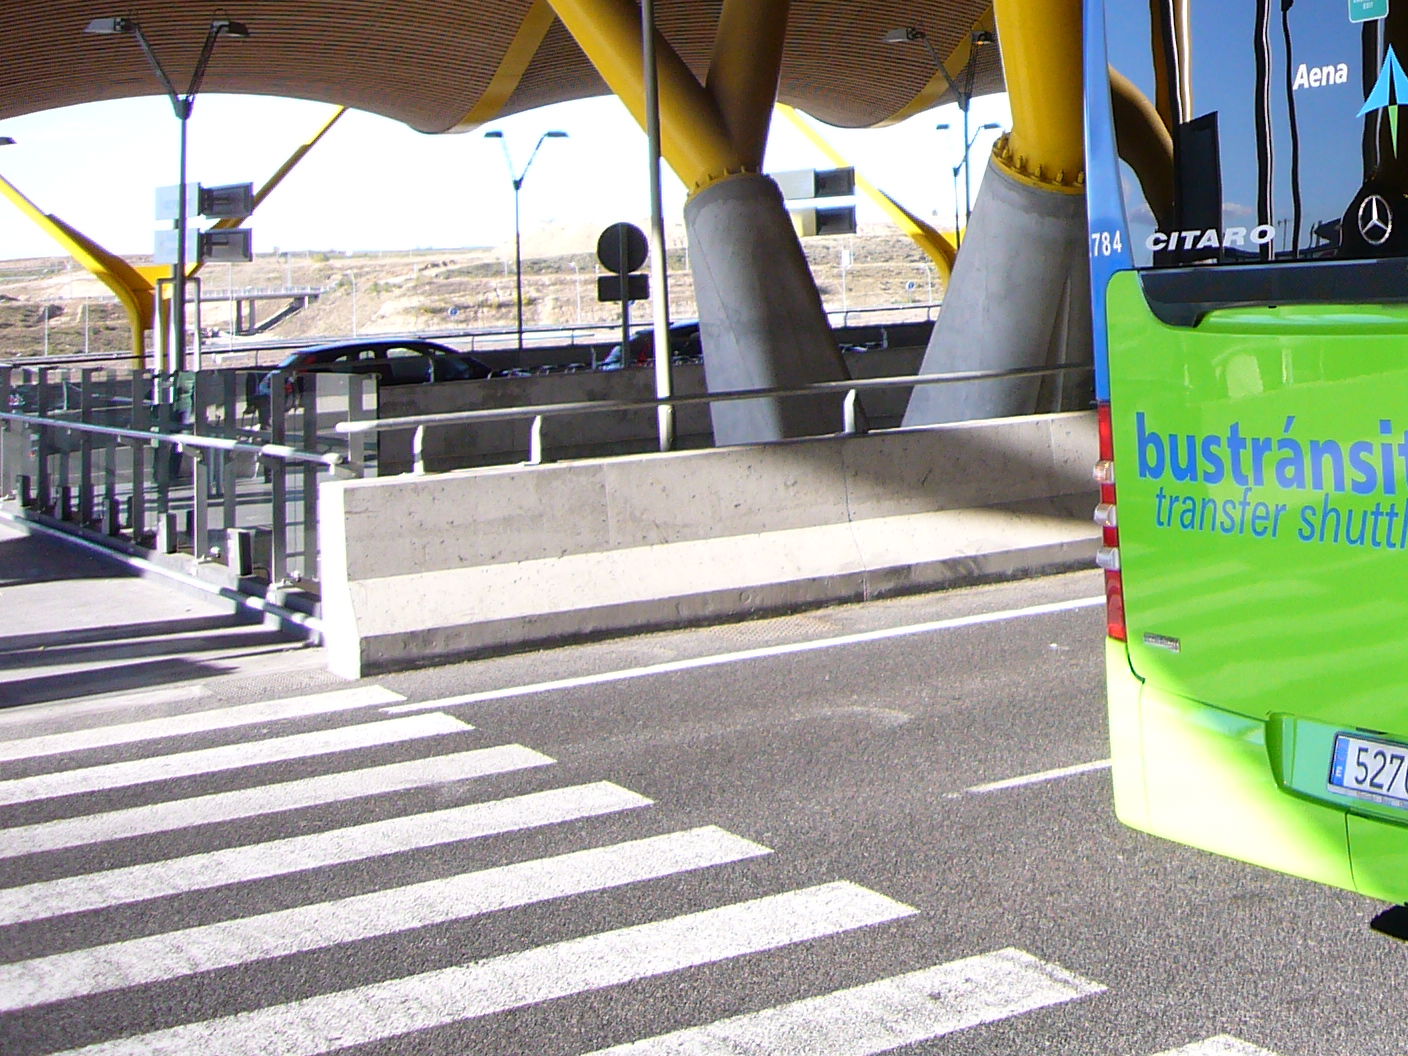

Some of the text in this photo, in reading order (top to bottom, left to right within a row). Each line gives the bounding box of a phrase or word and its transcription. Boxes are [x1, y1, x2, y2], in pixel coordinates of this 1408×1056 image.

[1293, 61, 1349, 91] Aena
[1089, 230, 1123, 257] 784
[1145, 224, 1276, 252] CITARO
[1155, 485, 1287, 540] transfer
